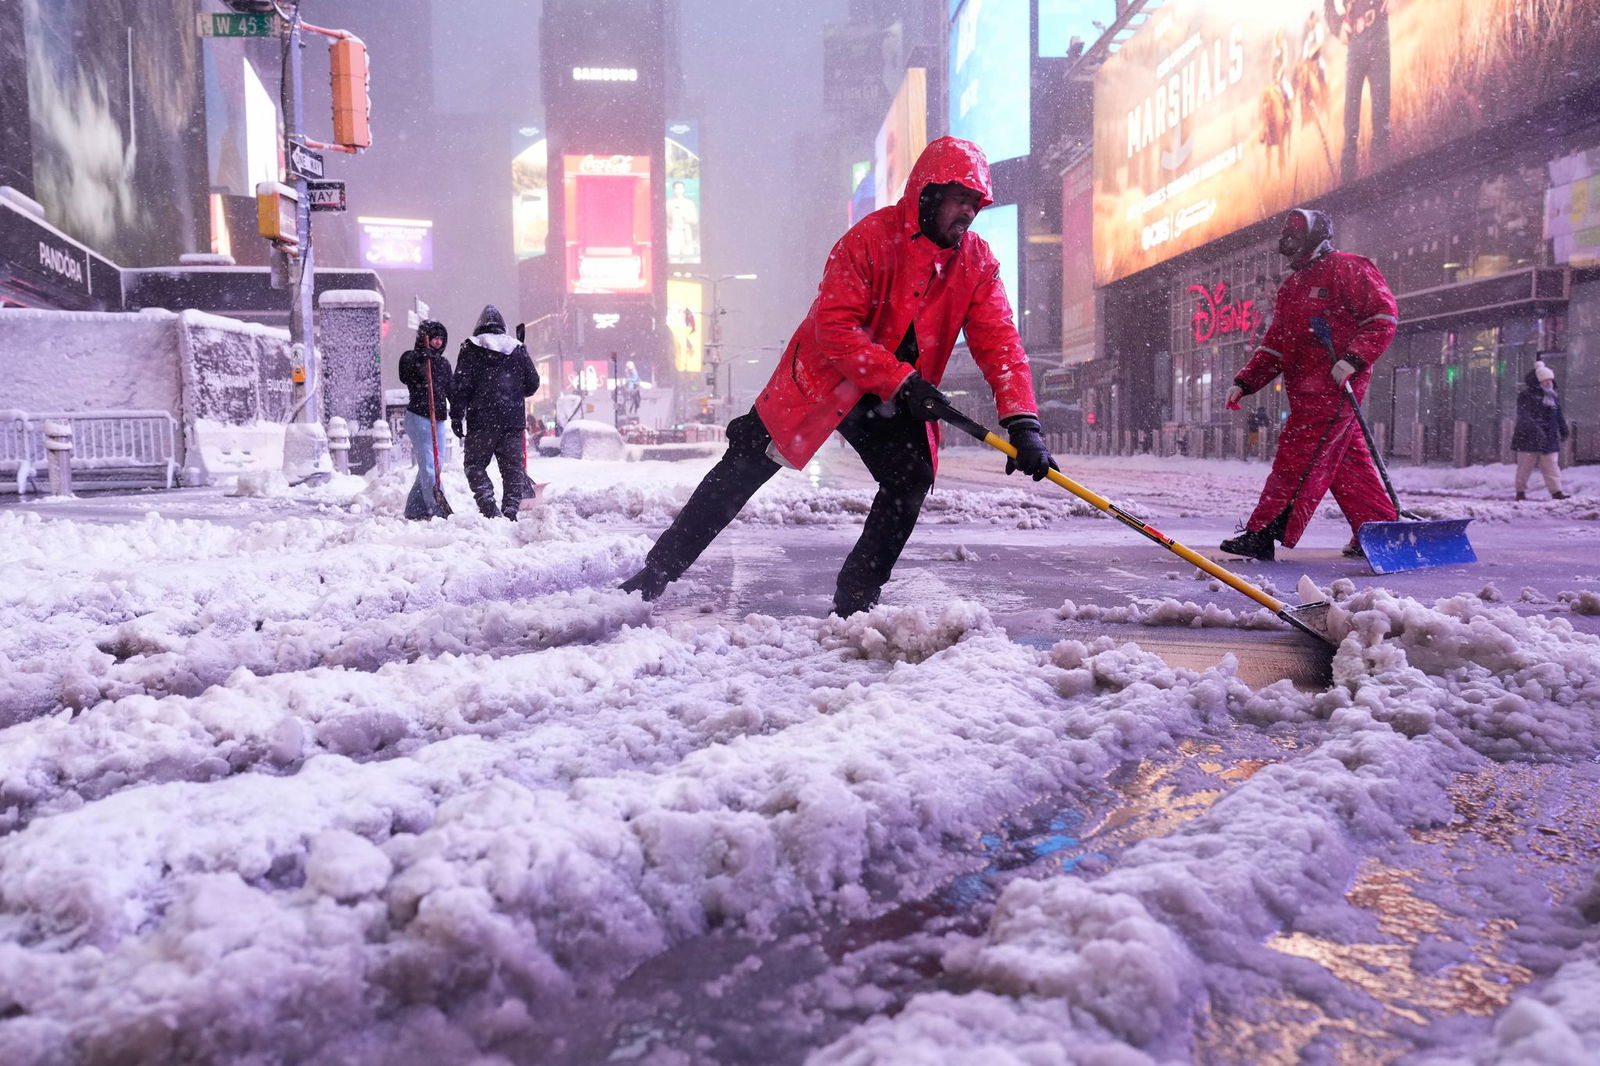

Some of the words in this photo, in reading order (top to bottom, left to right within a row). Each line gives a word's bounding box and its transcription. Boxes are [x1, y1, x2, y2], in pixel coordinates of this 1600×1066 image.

[216, 17, 231, 35] W
[238, 16, 257, 36] 45
[1127, 24, 1243, 158] MARSHALS
[309, 191, 333, 203] WAY
[39, 241, 83, 284] PANDORA
